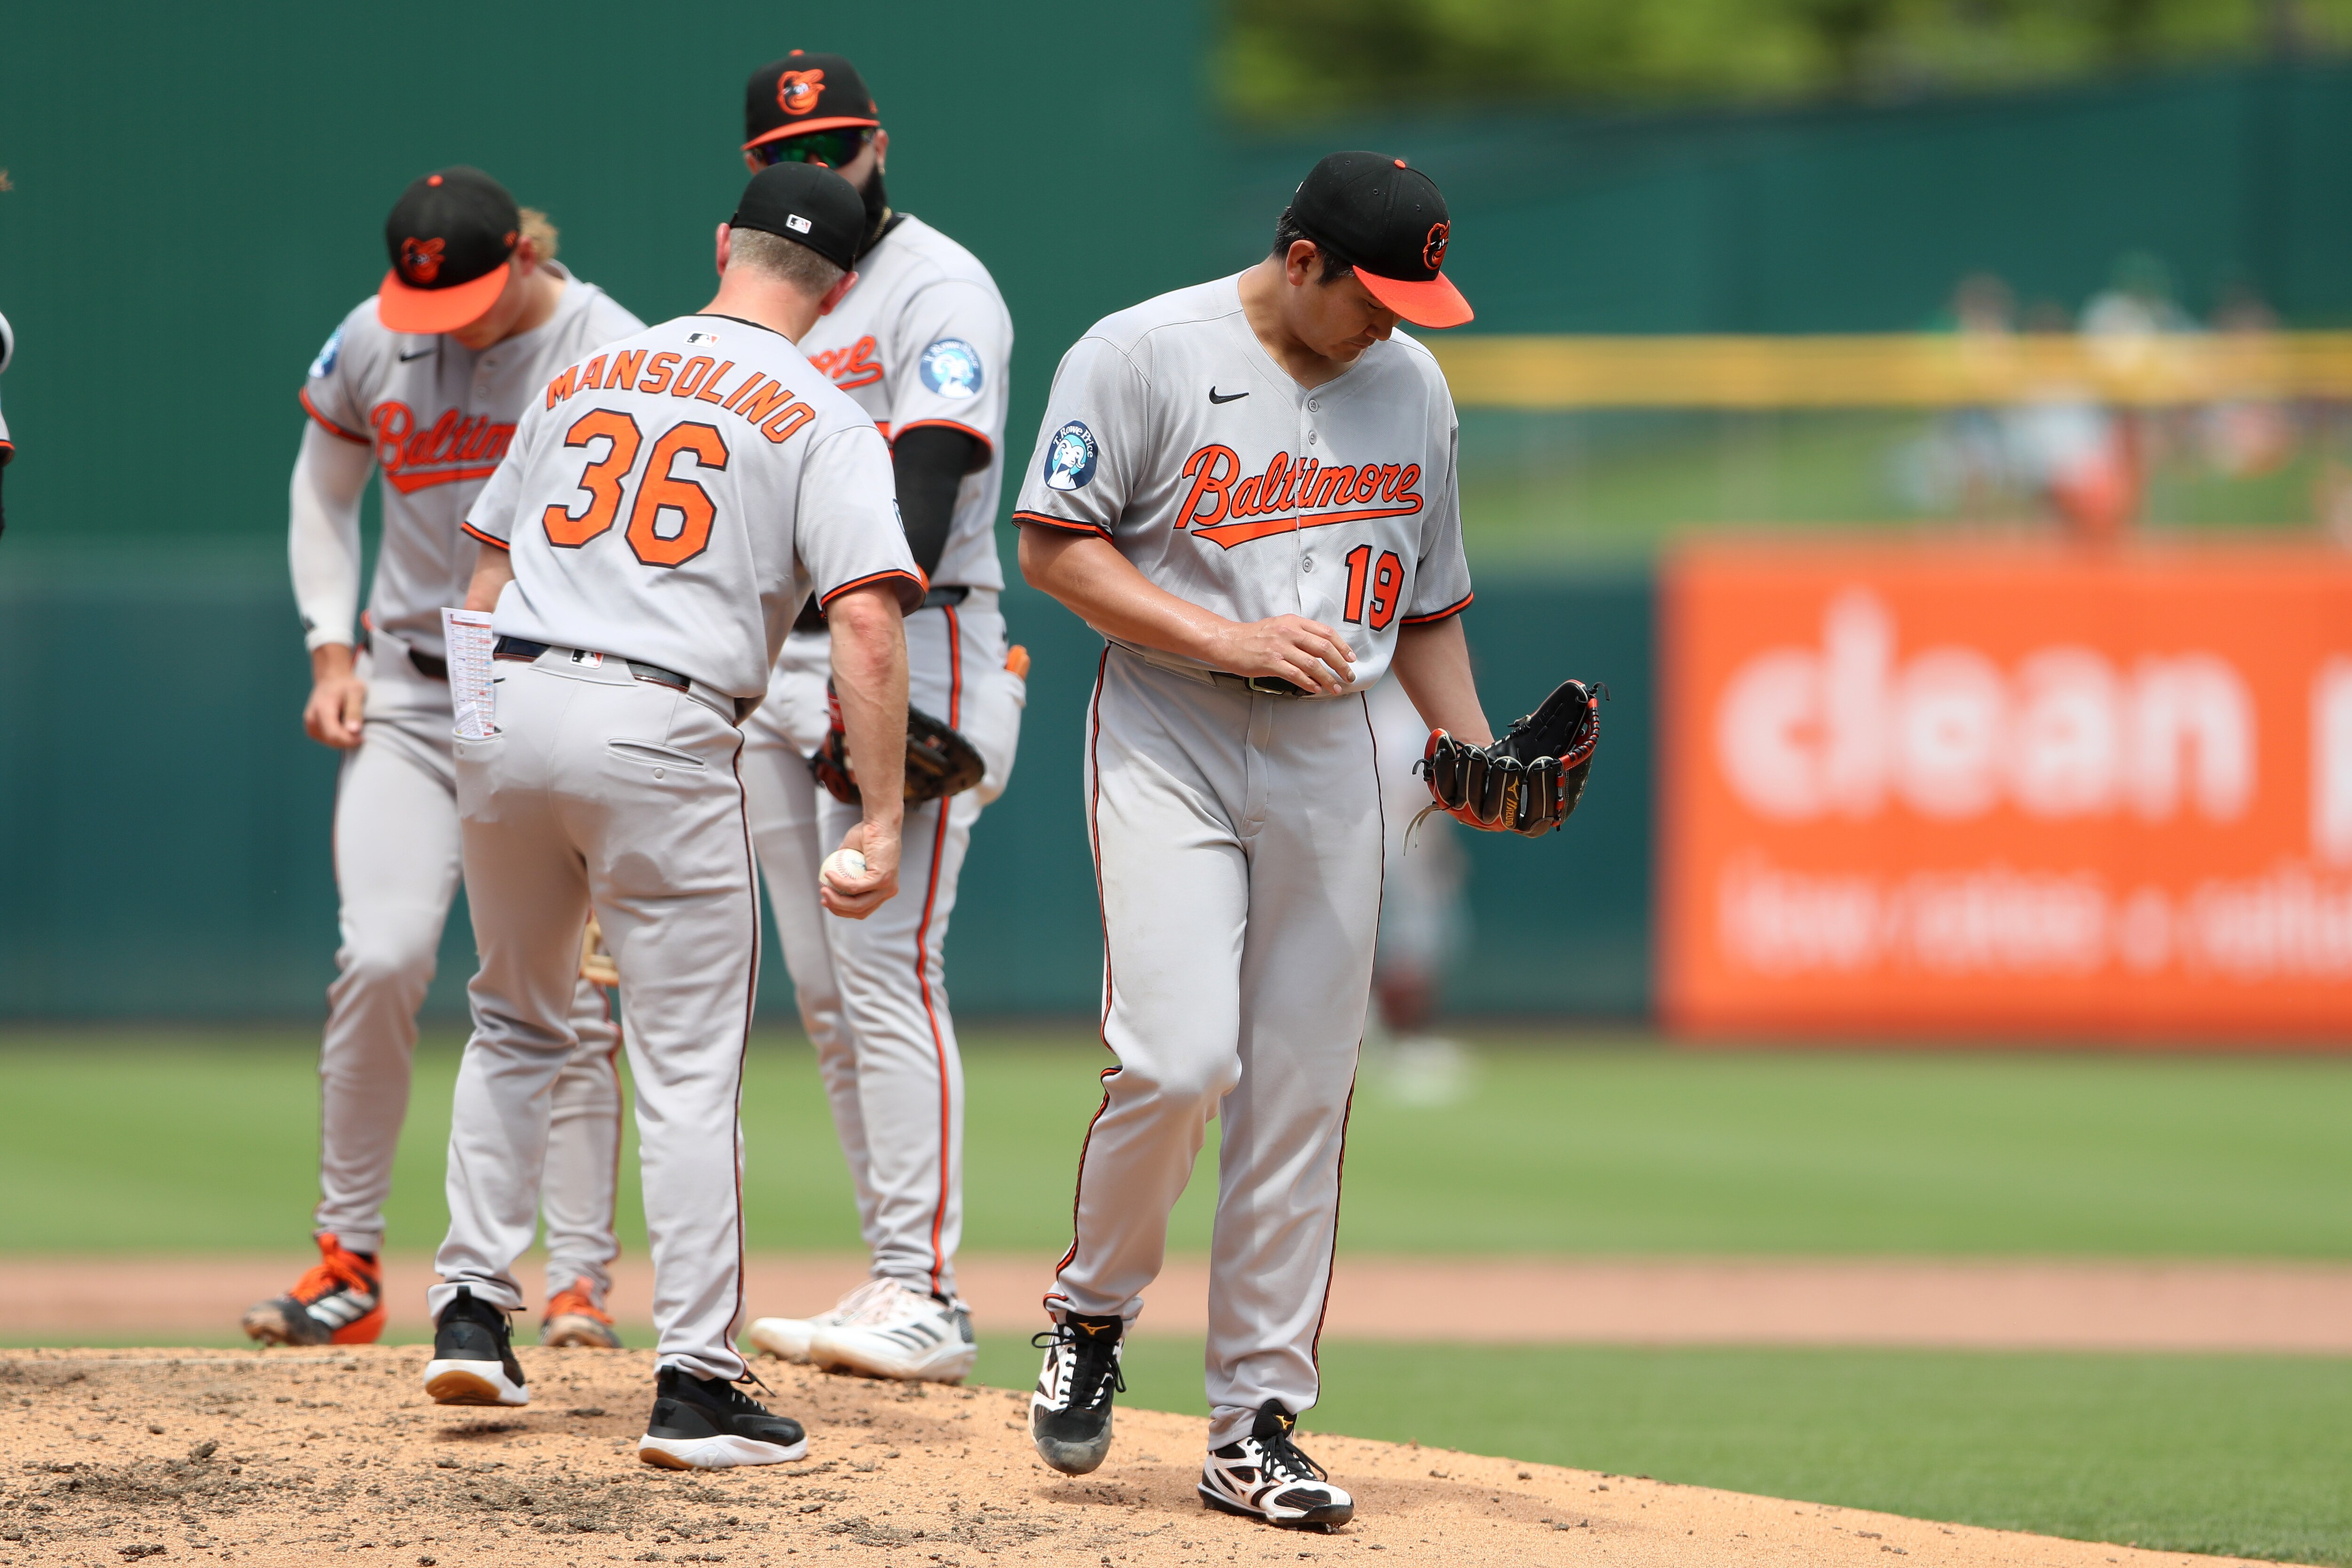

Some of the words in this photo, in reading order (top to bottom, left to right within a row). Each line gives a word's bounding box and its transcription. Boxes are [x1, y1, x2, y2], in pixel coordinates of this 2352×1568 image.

[371, 400, 517, 472] Baltim
[546, 350, 816, 444] MANSOLINO
[1081, 429, 1094, 458] Price
[1173, 444, 1424, 529] Baltimore
[542, 408, 730, 569] 36
[1343, 544, 1405, 632] 19
